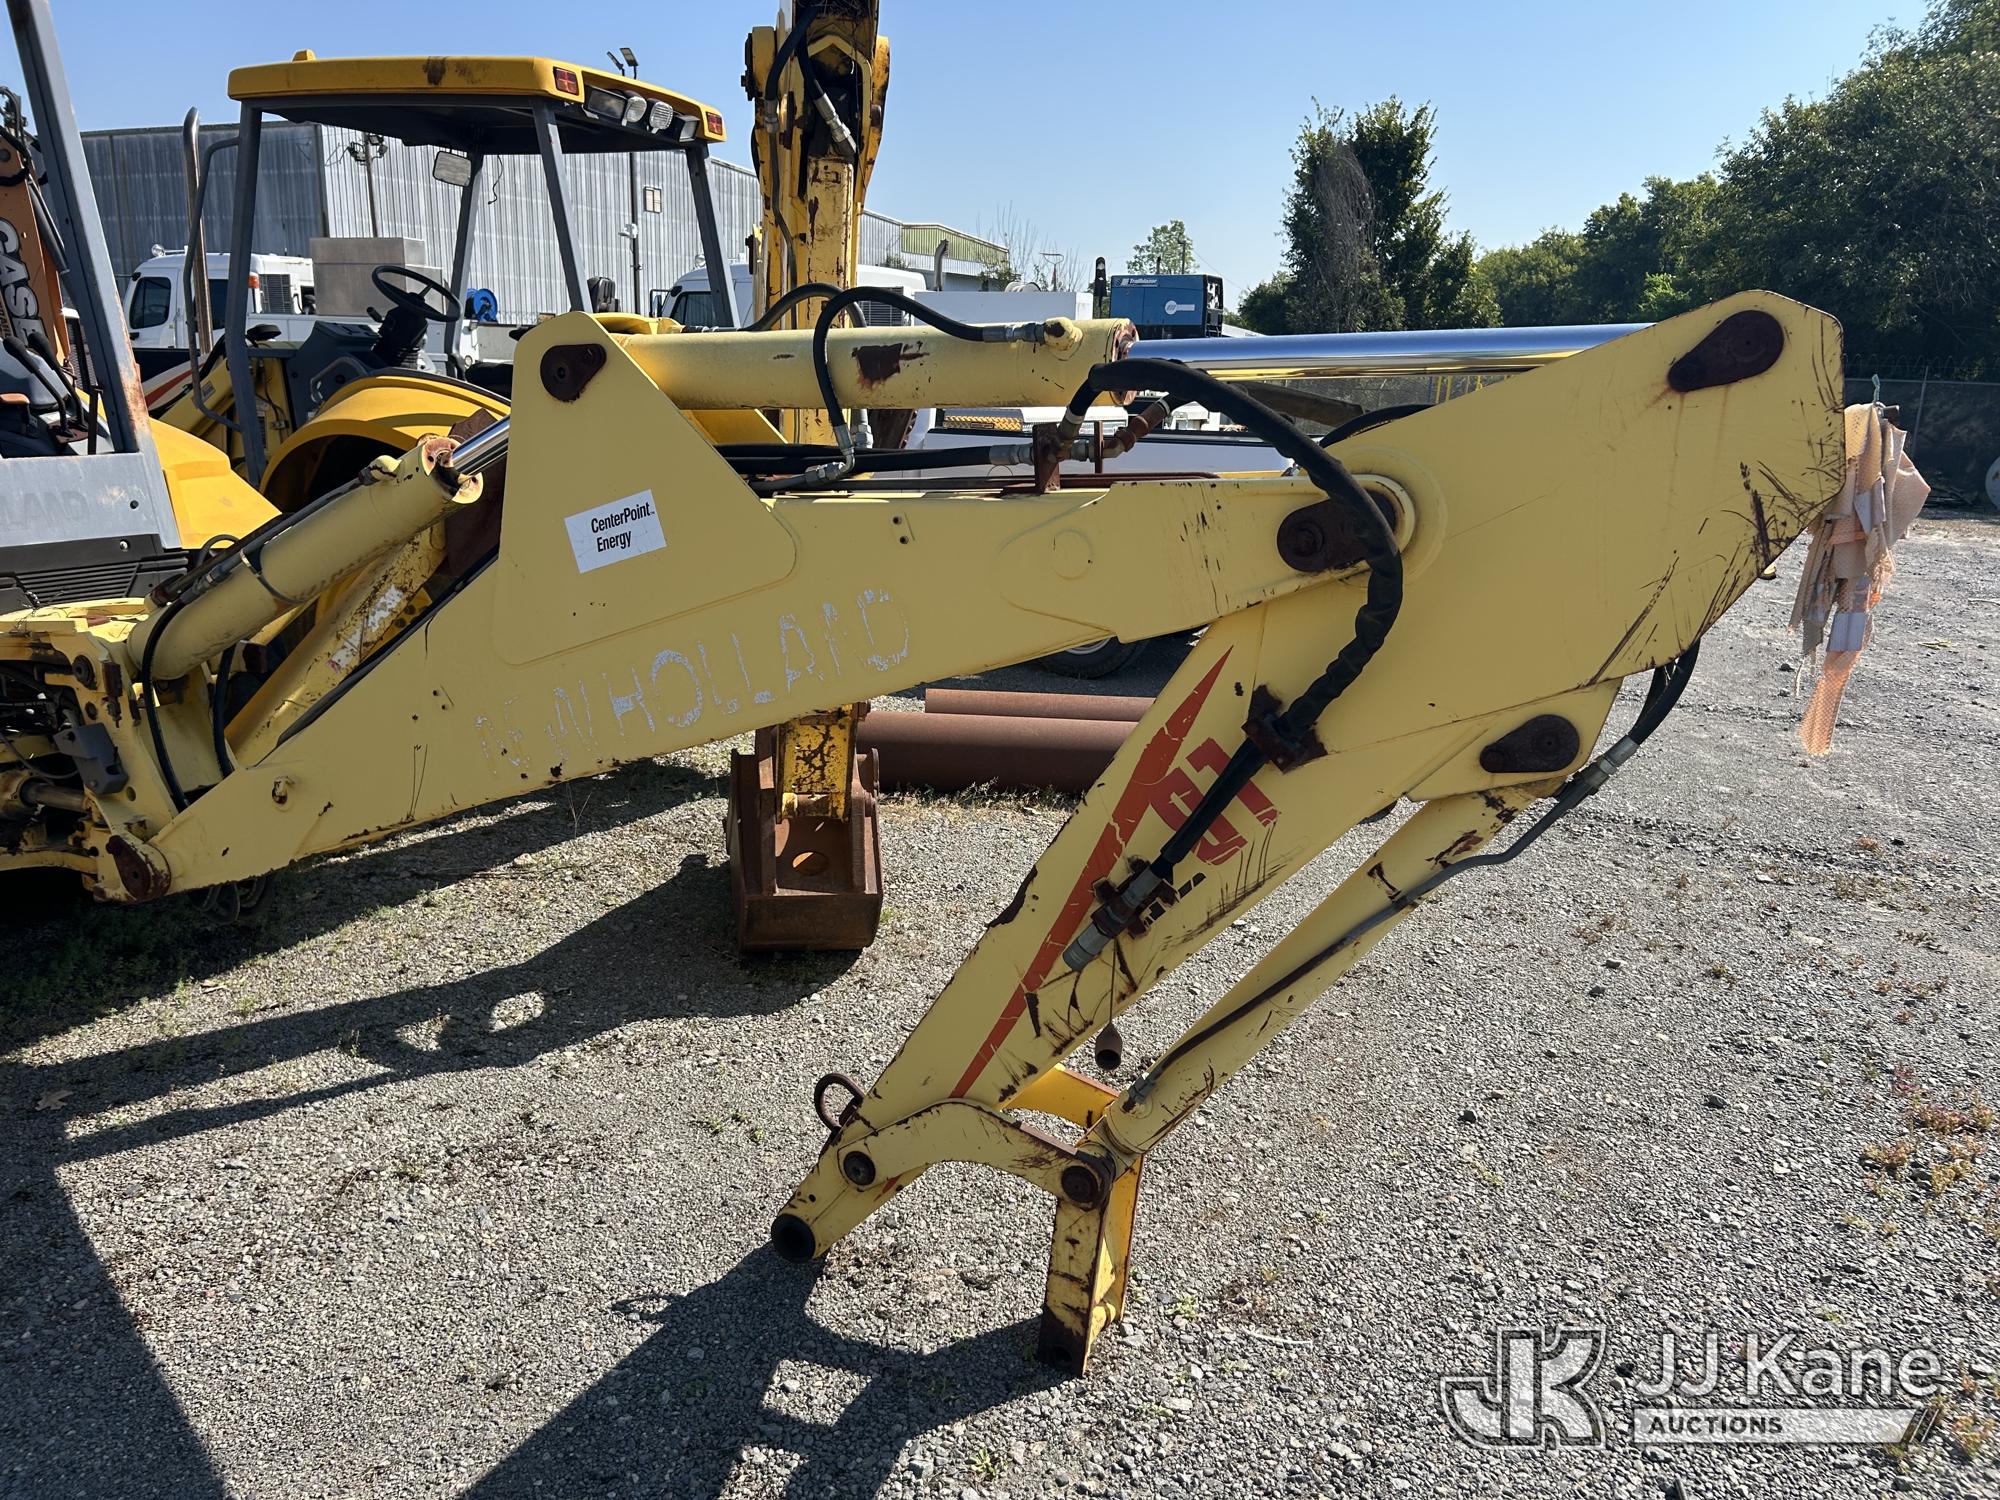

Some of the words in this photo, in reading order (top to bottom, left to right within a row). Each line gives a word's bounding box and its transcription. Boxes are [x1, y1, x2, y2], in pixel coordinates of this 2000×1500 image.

[0, 218, 49, 348] CASE
[591, 502, 651, 533] CenterPoint
[596, 531, 632, 553] Energy
